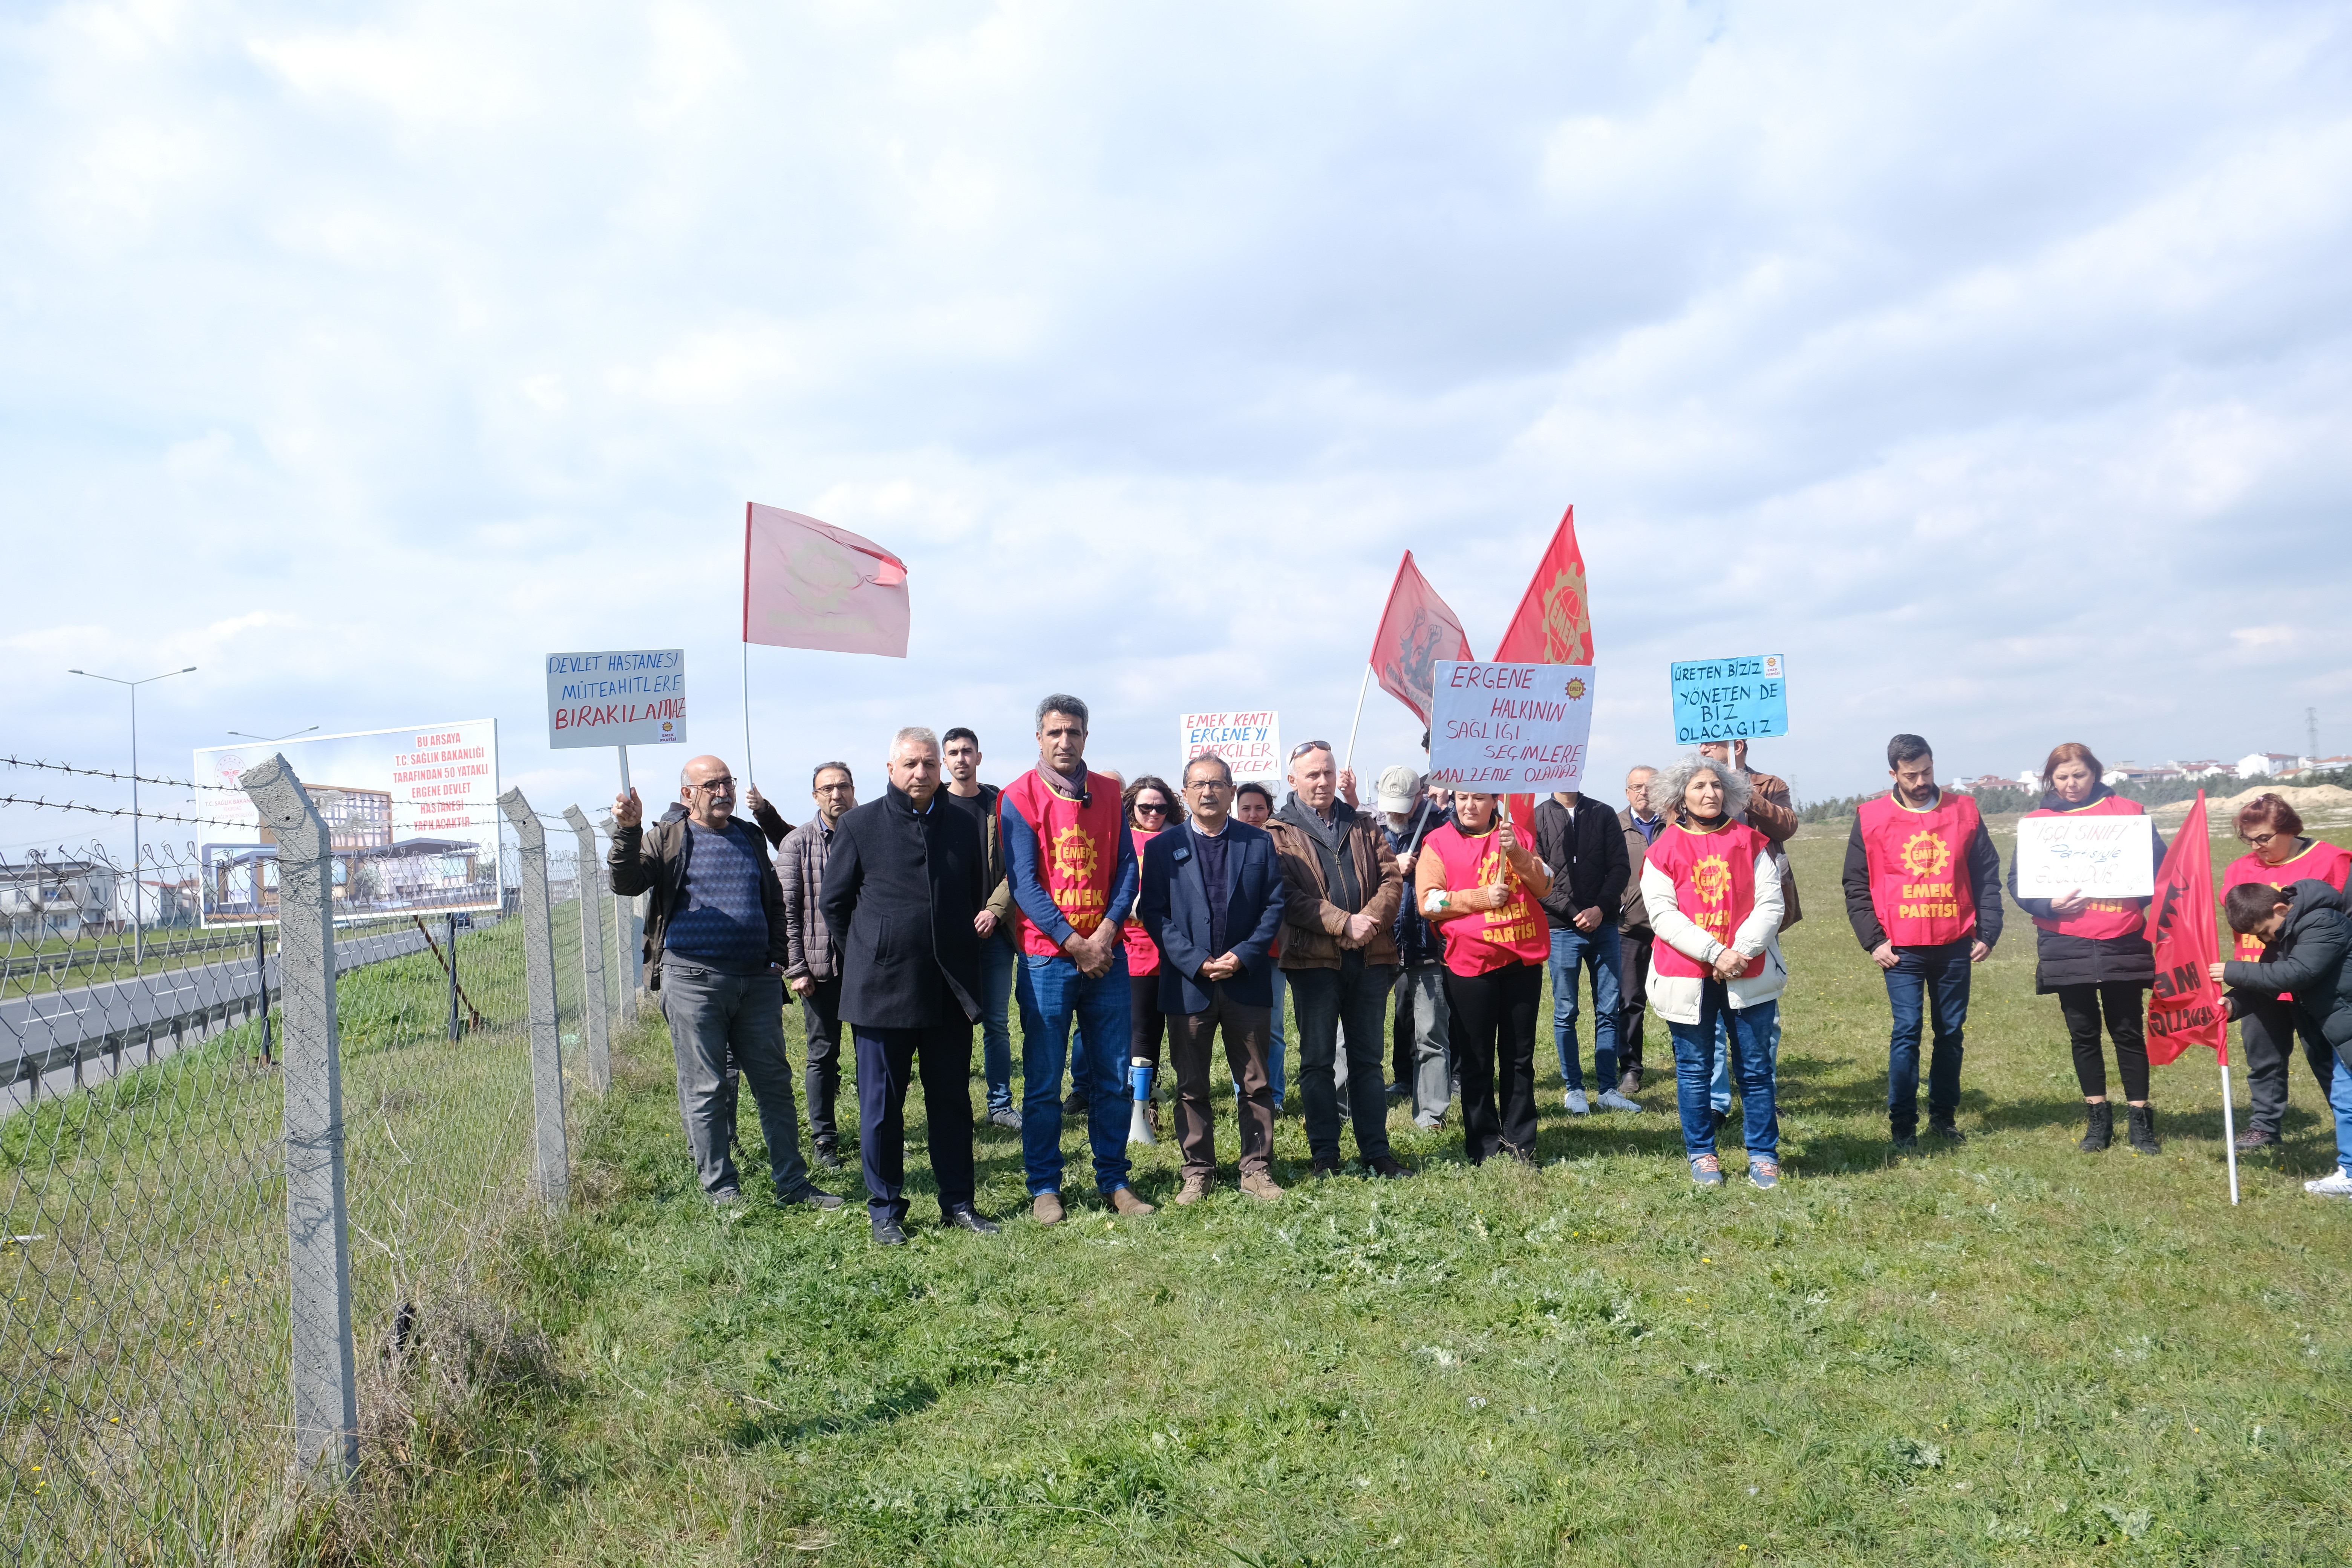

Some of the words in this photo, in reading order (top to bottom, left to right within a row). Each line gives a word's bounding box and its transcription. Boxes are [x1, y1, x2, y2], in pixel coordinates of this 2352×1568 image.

[1550, 598, 1576, 649] EMEP
[549, 656, 602, 674] DEVLET
[609, 650, 678, 671] HASTANESİ
[1675, 665, 1721, 681] ÜRETEN
[1728, 660, 1762, 677] BİZİZ
[562, 674, 682, 700] MÜTEAHİTLERE
[1451, 666, 1536, 689] ERGENE
[1680, 686, 1751, 706] YÖNETEN
[1760, 683, 1778, 700] DE
[556, 697, 686, 729] BIRAKILAMAZ
[1490, 698, 1567, 722] HALKININ
[1701, 703, 1738, 722] BİZ
[1187, 714, 1228, 728] EMEK
[1233, 712, 1274, 726] KENTİ
[1446, 718, 1520, 740] SAĞLIĞI
[417, 736, 428, 747] BU
[430, 732, 461, 746] ARSAYA
[1190, 726, 1269, 743] ERGENE'Yİ
[395, 755, 409, 766] T.C.
[410, 750, 439, 765] SAĞLIK
[441, 745, 484, 762] BAKANLIĞI
[393, 768, 442, 783] TARAFINDAN
[444, 767, 455, 778] 50
[457, 764, 488, 777] YATAKLI
[1228, 759, 1277, 773] TECEK!
[1432, 767, 1514, 783] MALZEME
[1525, 764, 1577, 782] OLAMAZ
[412, 785, 441, 798] ERGENE
[443, 782, 471, 795] DEVLET
[420, 798, 464, 814] HASTANESİ
[1063, 847, 1090, 859] EMEP
[1913, 849, 1940, 861] EMEP
[1054, 888, 1104, 906] EMEK
[1902, 883, 1953, 899] EMEK
[1484, 902, 1530, 923] EMEK
[1899, 899, 1957, 918] PARTİSİ
[1482, 917, 1537, 943] PARTİSİ
[2242, 934, 2266, 949] EM
